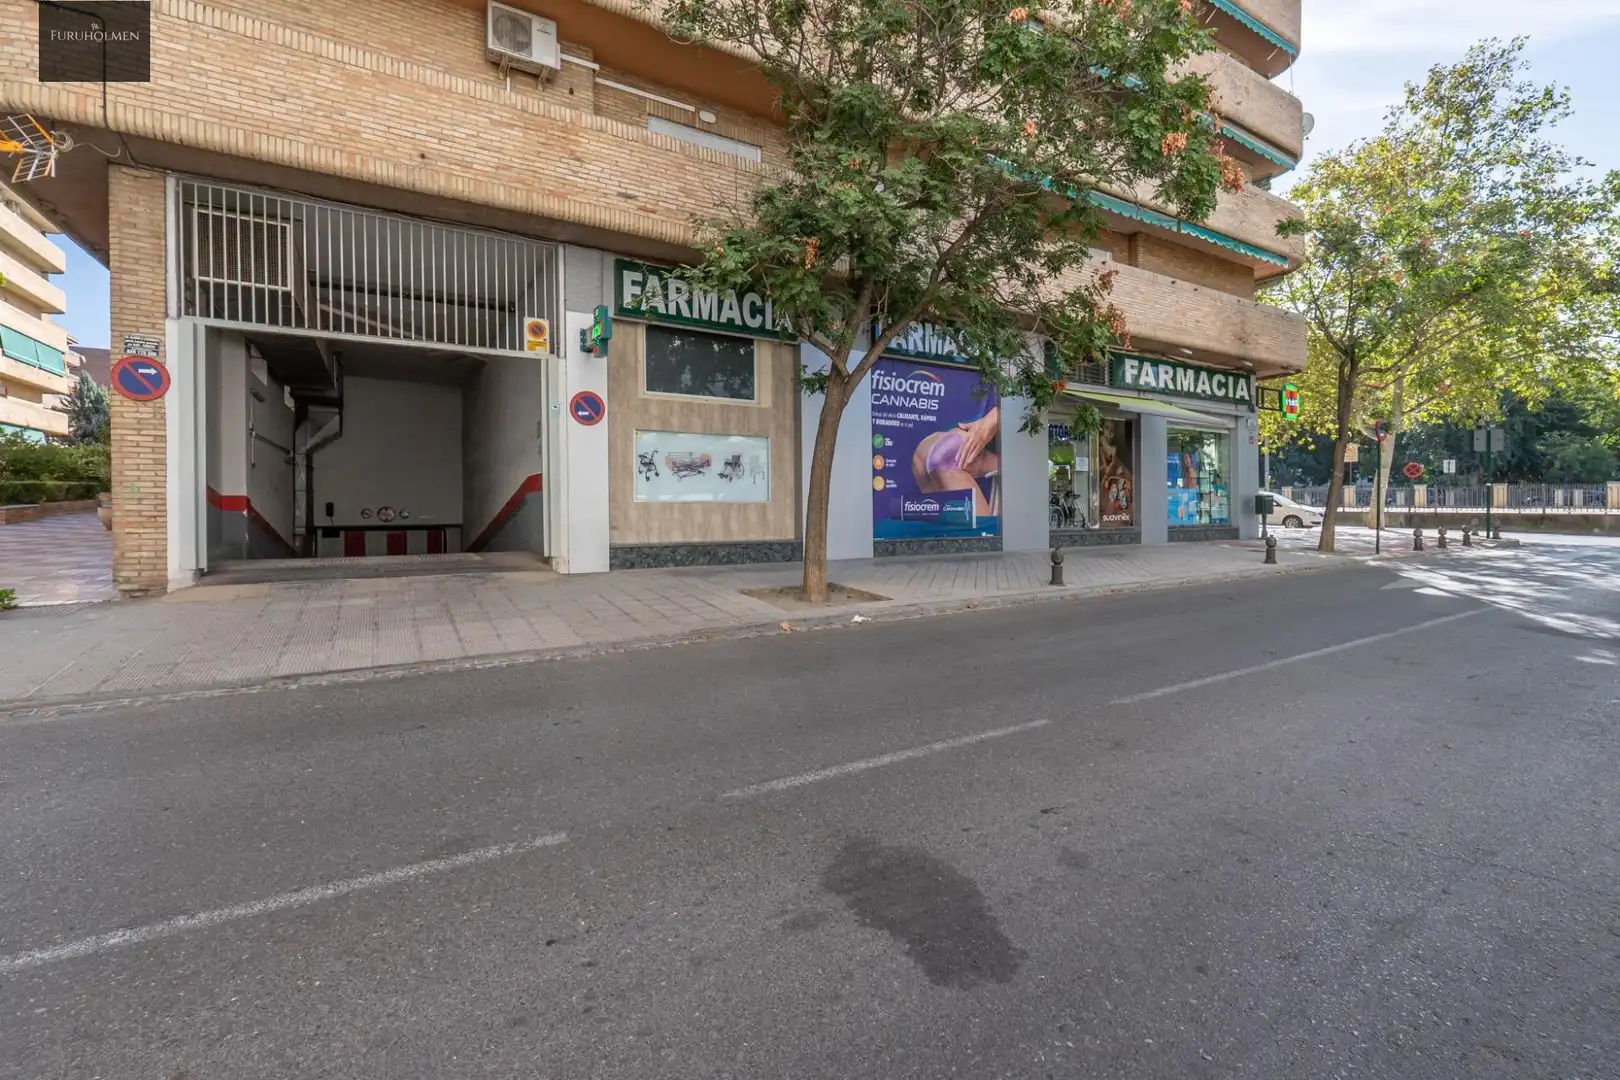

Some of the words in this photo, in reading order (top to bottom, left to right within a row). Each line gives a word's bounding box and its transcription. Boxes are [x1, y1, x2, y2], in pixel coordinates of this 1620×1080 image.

[622, 269, 794, 334] FARMACIA
[871, 369, 945, 397] fisiocrem
[1124, 358, 1250, 400] FARMACIA
[871, 393, 939, 410] CANNABIS
[904, 500, 940, 513] fisiocrem
